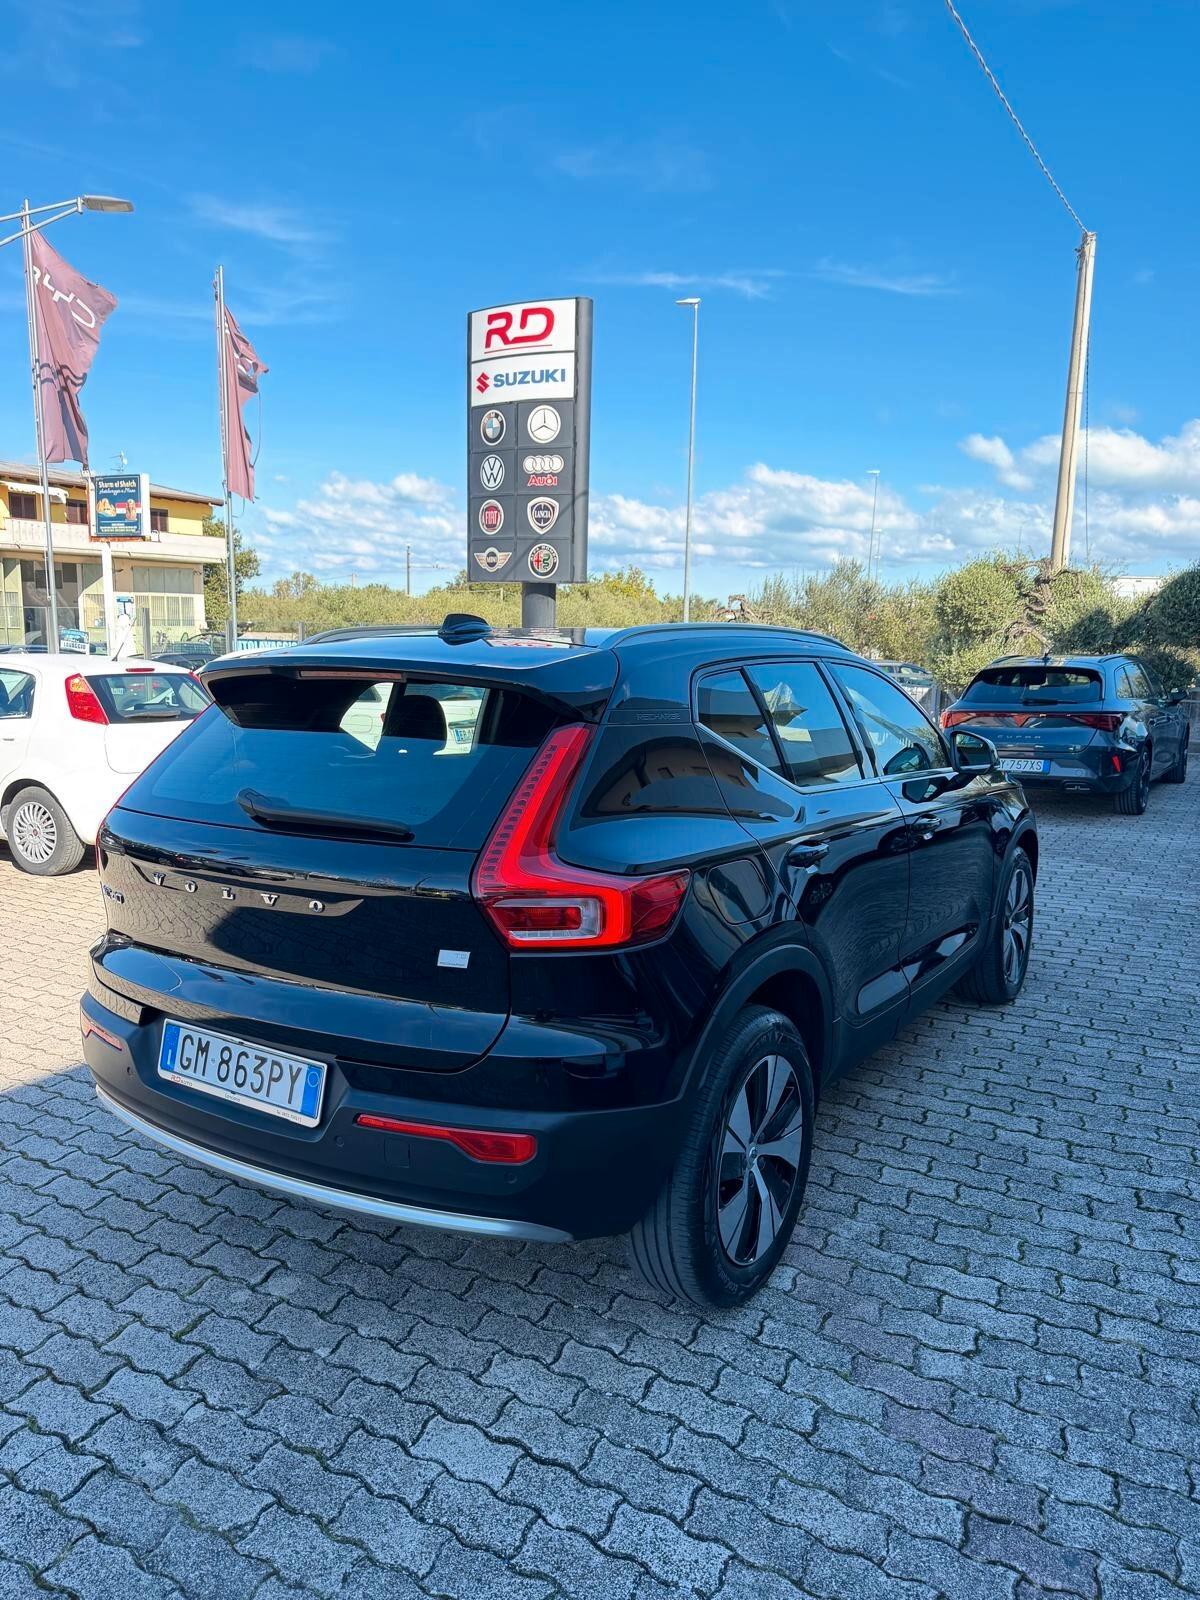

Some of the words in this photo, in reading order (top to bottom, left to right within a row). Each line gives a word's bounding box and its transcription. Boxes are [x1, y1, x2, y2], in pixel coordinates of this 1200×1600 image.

[485, 307, 555, 349] RD
[493, 368, 566, 388] SUZUKI
[527, 474, 558, 487] Audi
[485, 510, 498, 525] FIAT
[1009, 760, 1042, 771] 757XS
[152, 872, 325, 914] VOLVO
[217, 1045, 302, 1105] 863PY
